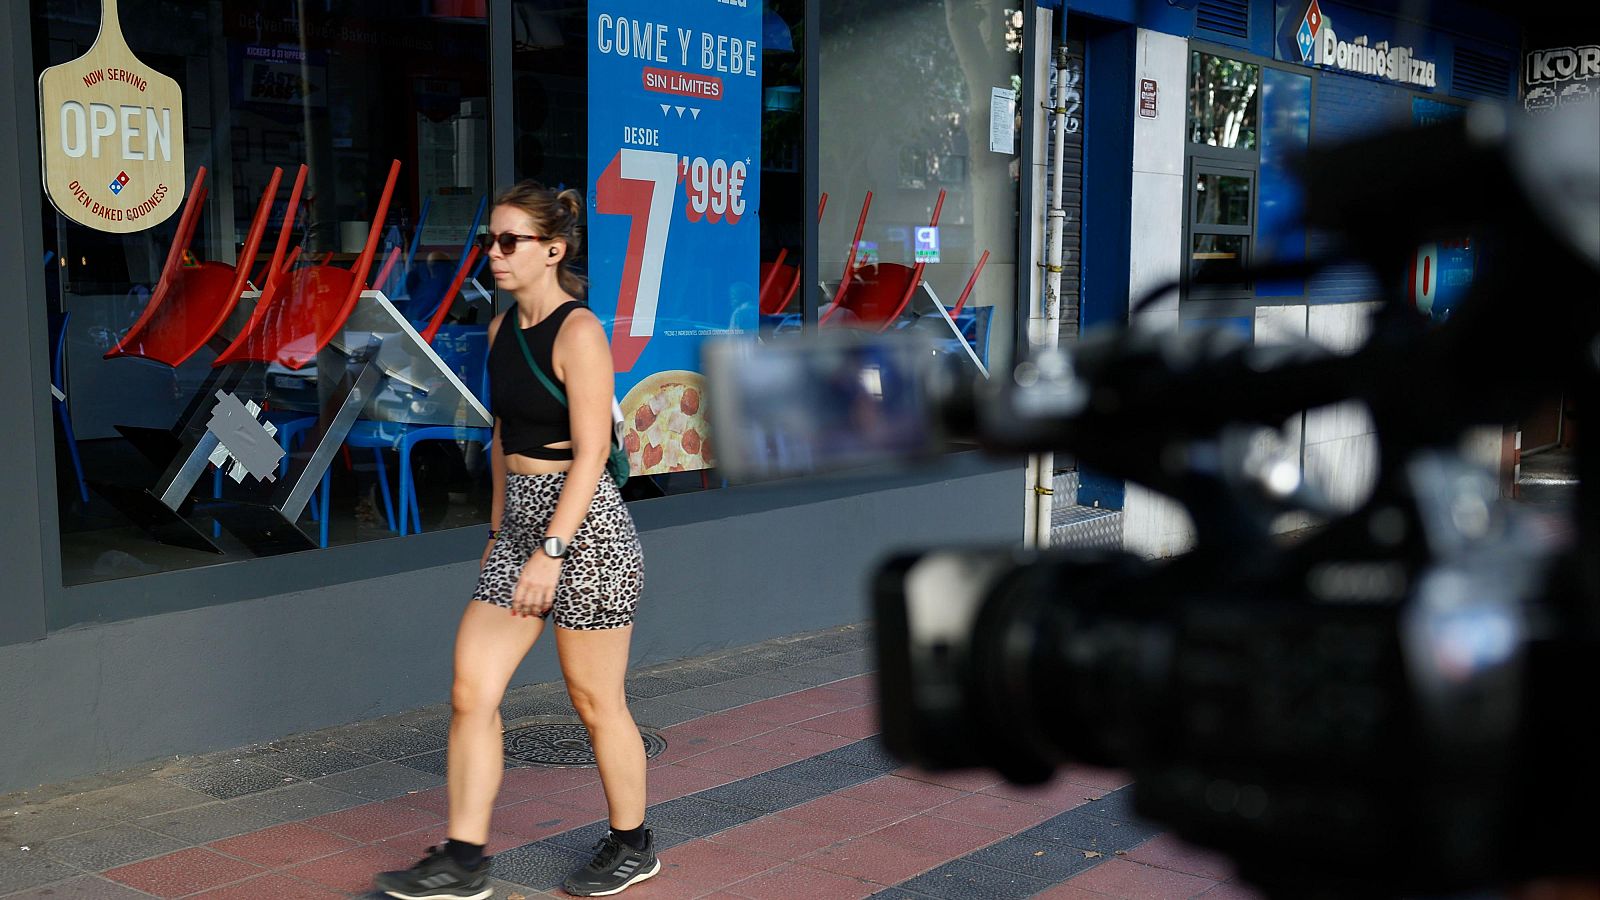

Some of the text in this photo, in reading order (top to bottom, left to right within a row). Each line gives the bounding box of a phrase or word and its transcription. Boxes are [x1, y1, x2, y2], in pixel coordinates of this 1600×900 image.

[598, 13, 756, 77] COME Y BEBE
[1314, 27, 1436, 88] Domino's Pizza
[83, 68, 147, 93] NOW SERVING
[646, 73, 719, 96] SIN LÍMITES
[60, 100, 171, 162] OPEN
[624, 126, 659, 147] DESDE
[69, 180, 168, 221] OVEN BAKED GOODNESS
